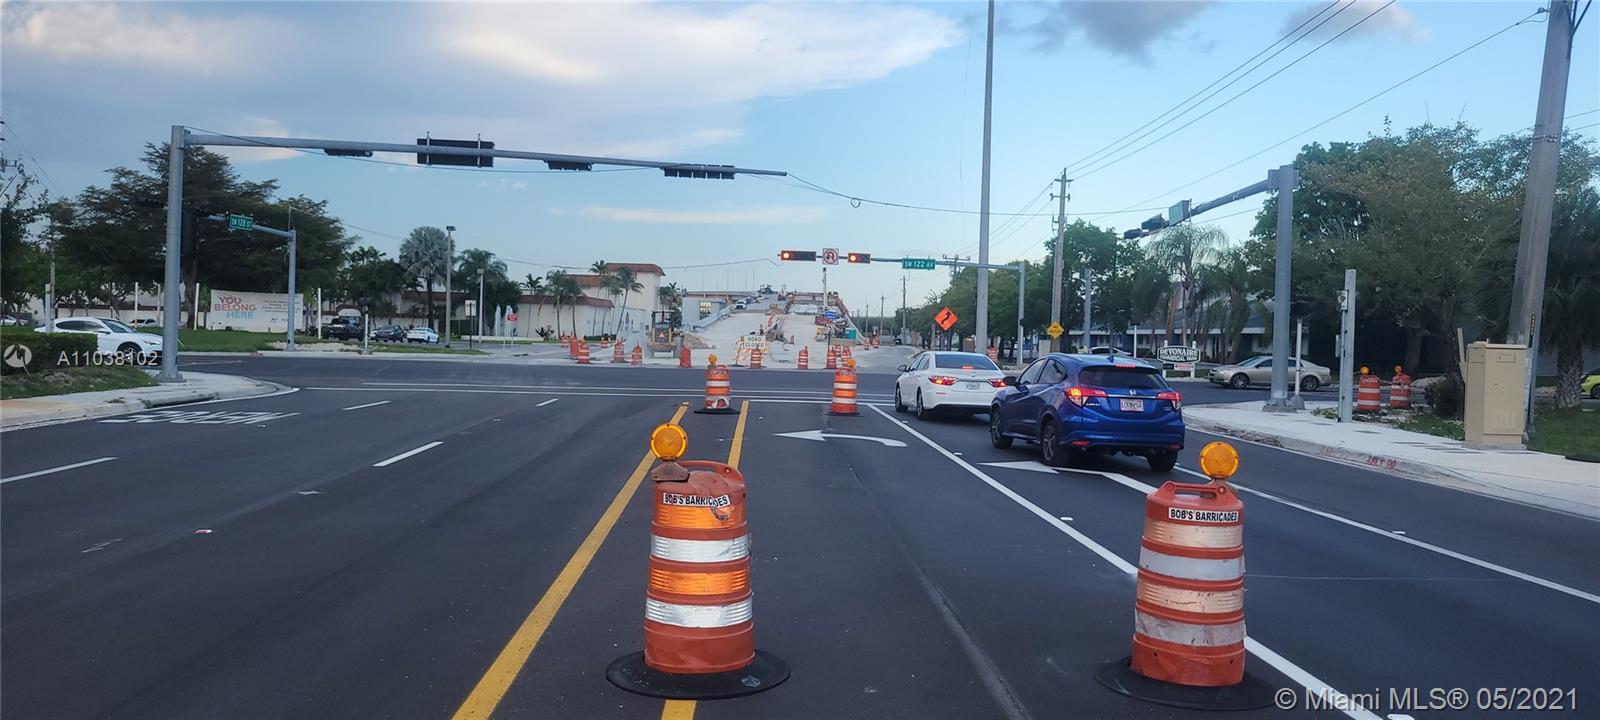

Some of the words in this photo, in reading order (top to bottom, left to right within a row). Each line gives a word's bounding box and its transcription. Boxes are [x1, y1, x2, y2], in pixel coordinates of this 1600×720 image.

[219, 297, 241, 305] YOU
[214, 303, 256, 312] BELONG
[226, 311, 255, 319] HERE
[1160, 347, 1198, 356] DEVONAIRE
[665, 494, 684, 505] BOB'S
[1170, 508, 1194, 520] BOB'S
[1195, 511, 1237, 522] BARRICADES
